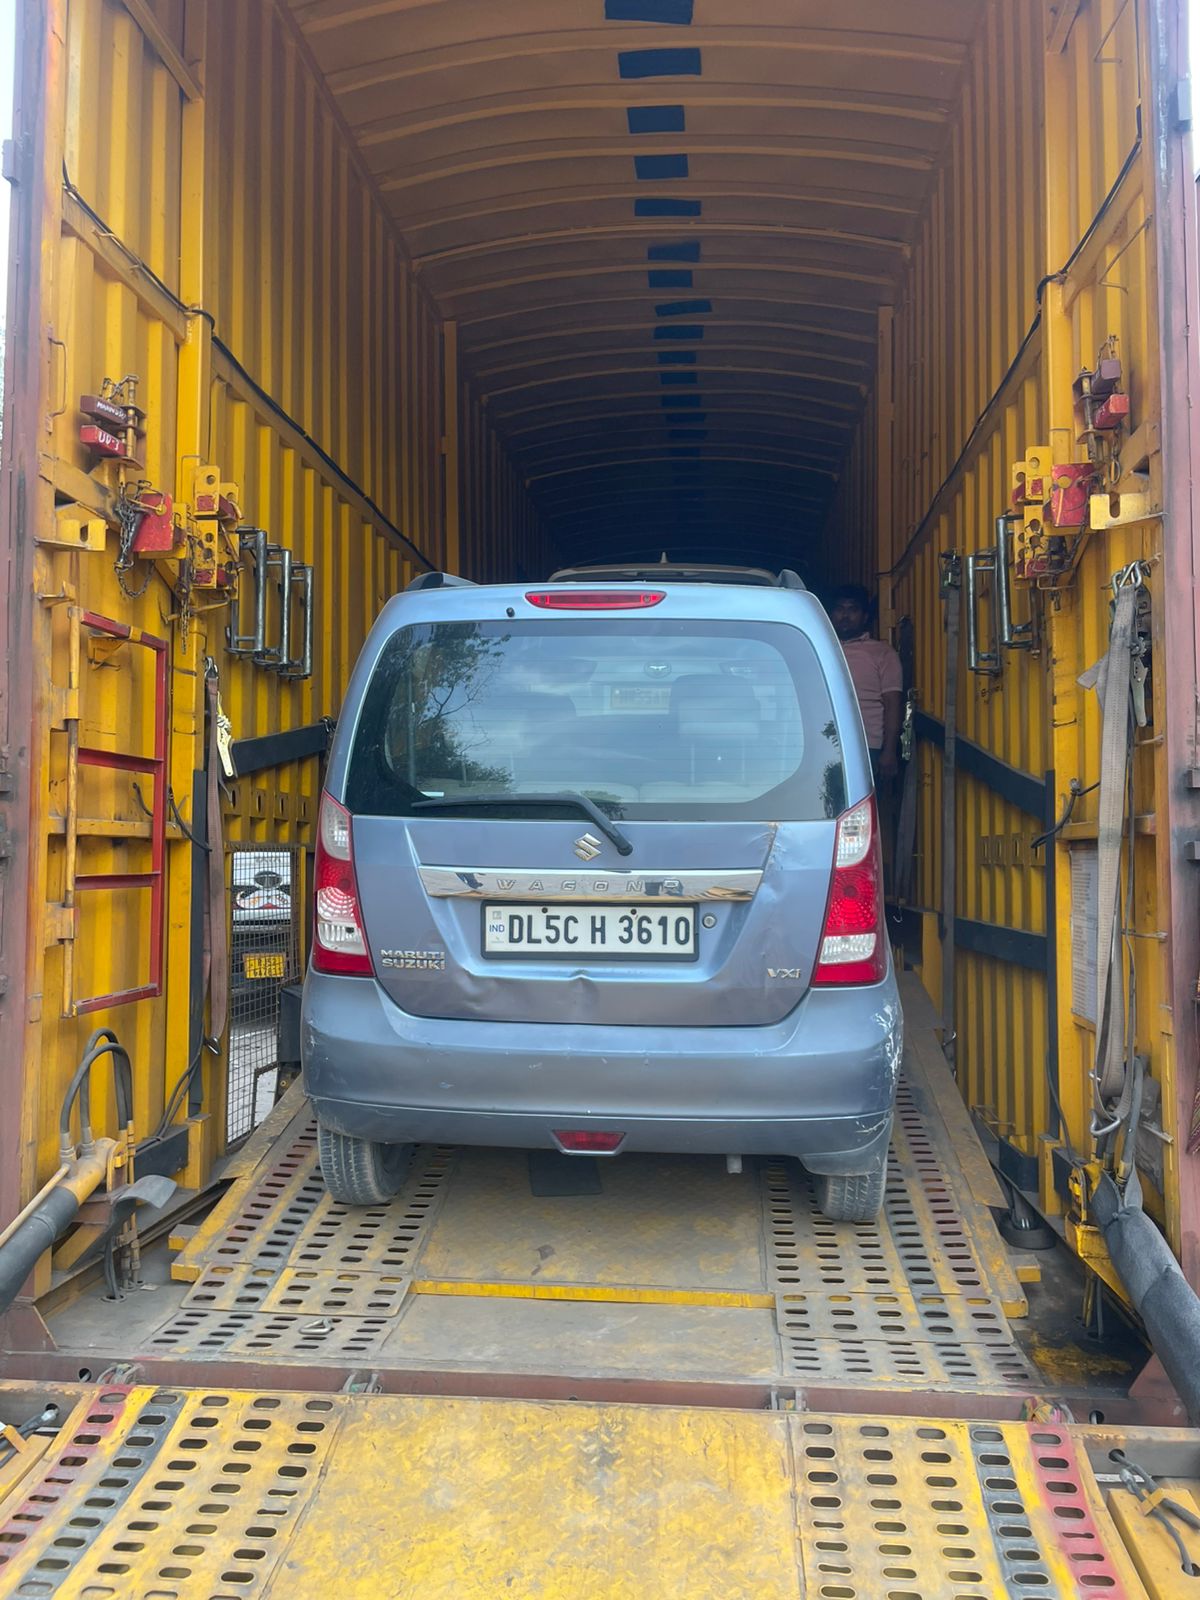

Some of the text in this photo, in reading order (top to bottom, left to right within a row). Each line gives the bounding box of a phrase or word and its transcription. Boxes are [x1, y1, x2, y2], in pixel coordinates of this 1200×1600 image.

[489, 924, 505, 933] IND
[508, 914, 690, 946] DL5C H 3610
[380, 949, 445, 960] MARUTI
[381, 959, 446, 970] SUZUKI
